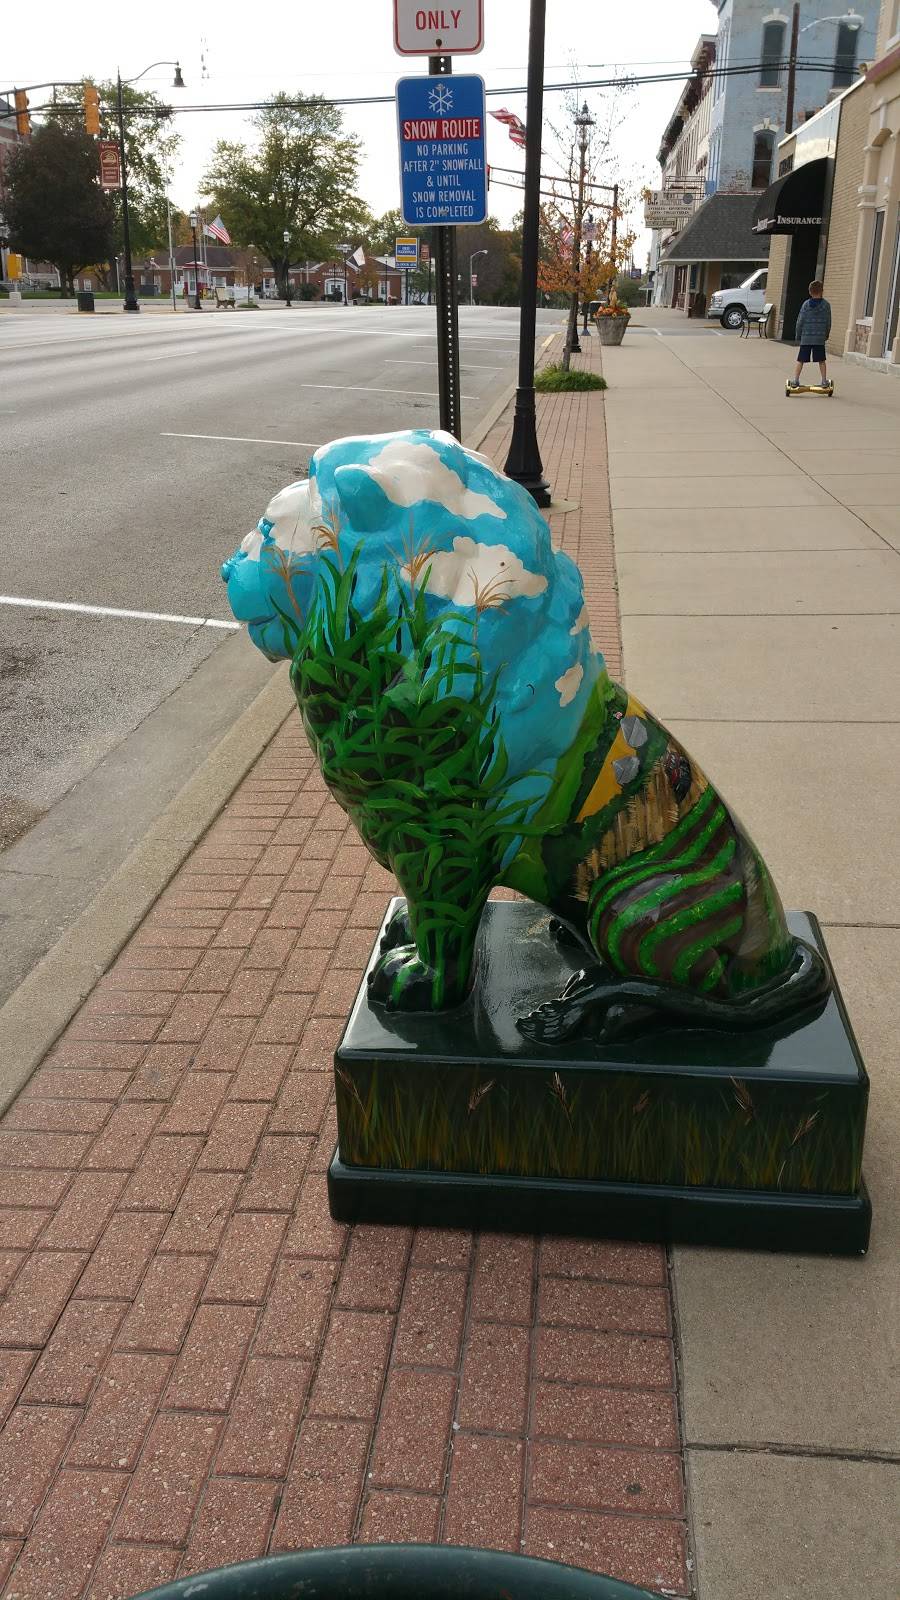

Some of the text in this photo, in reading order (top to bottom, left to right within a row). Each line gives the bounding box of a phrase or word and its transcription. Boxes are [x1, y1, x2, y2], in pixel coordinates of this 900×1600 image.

[415, 10, 461, 30] ONLY
[404, 119, 480, 140] SNOW ROUTE
[416, 143, 468, 157] NO PARKING
[403, 160, 431, 172] AFTER
[442, 158, 483, 171] SNOWFALL
[426, 175, 461, 187] & UNTIL
[412, 190, 477, 203] SNOW REMOVAL
[416, 205, 474, 218] IS COMPLETED
[777, 215, 822, 225] INSURANCE
